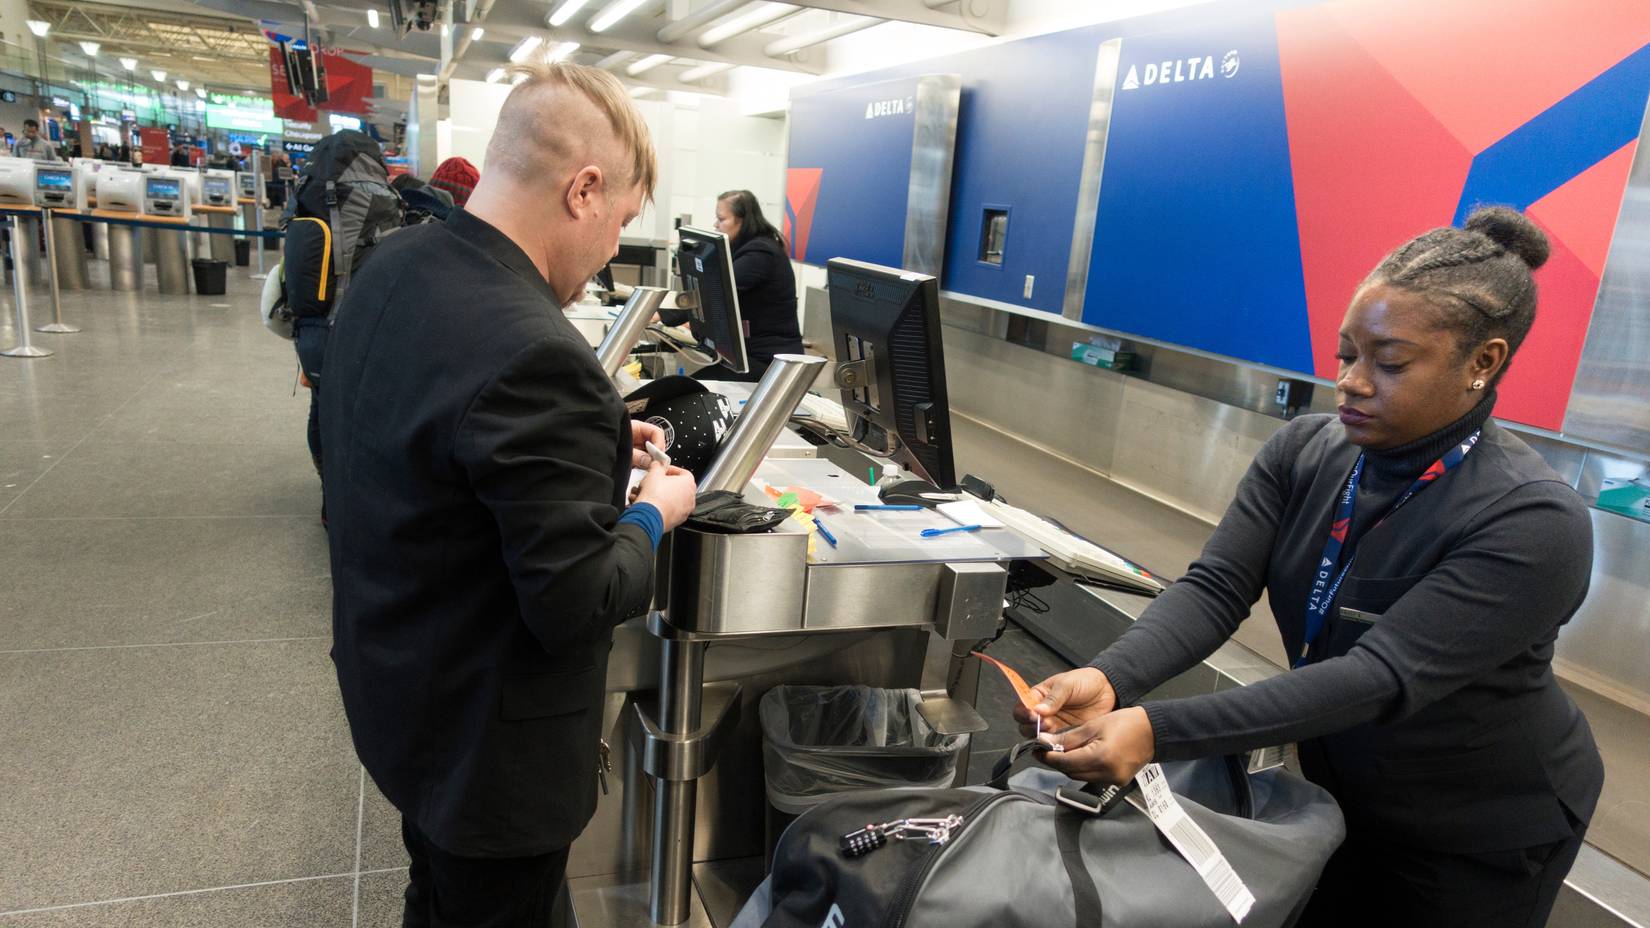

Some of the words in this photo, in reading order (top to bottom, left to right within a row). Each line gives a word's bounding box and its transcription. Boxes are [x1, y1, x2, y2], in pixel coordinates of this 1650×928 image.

[1144, 56, 1214, 85] DELTA
[874, 99, 904, 116] DELTA
[1309, 571, 1328, 610] DELTA
